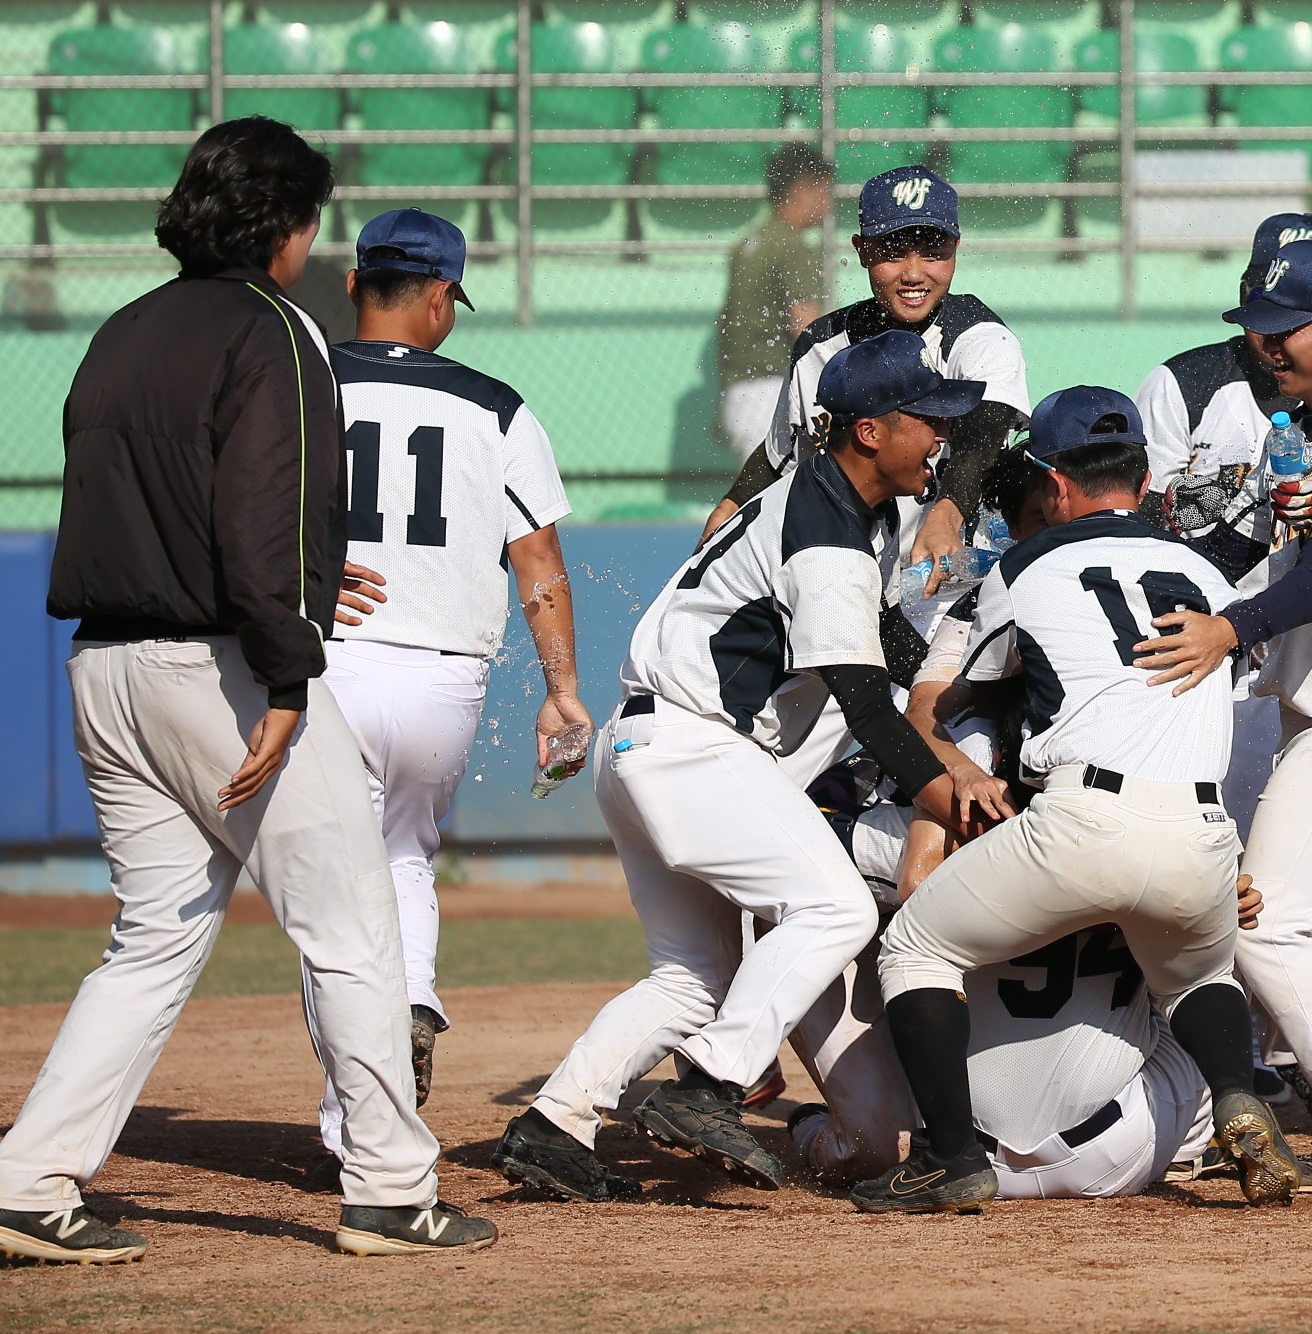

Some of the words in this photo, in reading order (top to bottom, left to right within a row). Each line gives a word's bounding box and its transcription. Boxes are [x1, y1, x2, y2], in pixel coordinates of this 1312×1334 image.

[345, 420, 447, 548] 11
[40, 1208, 89, 1240] N
[409, 1209, 451, 1241] N
